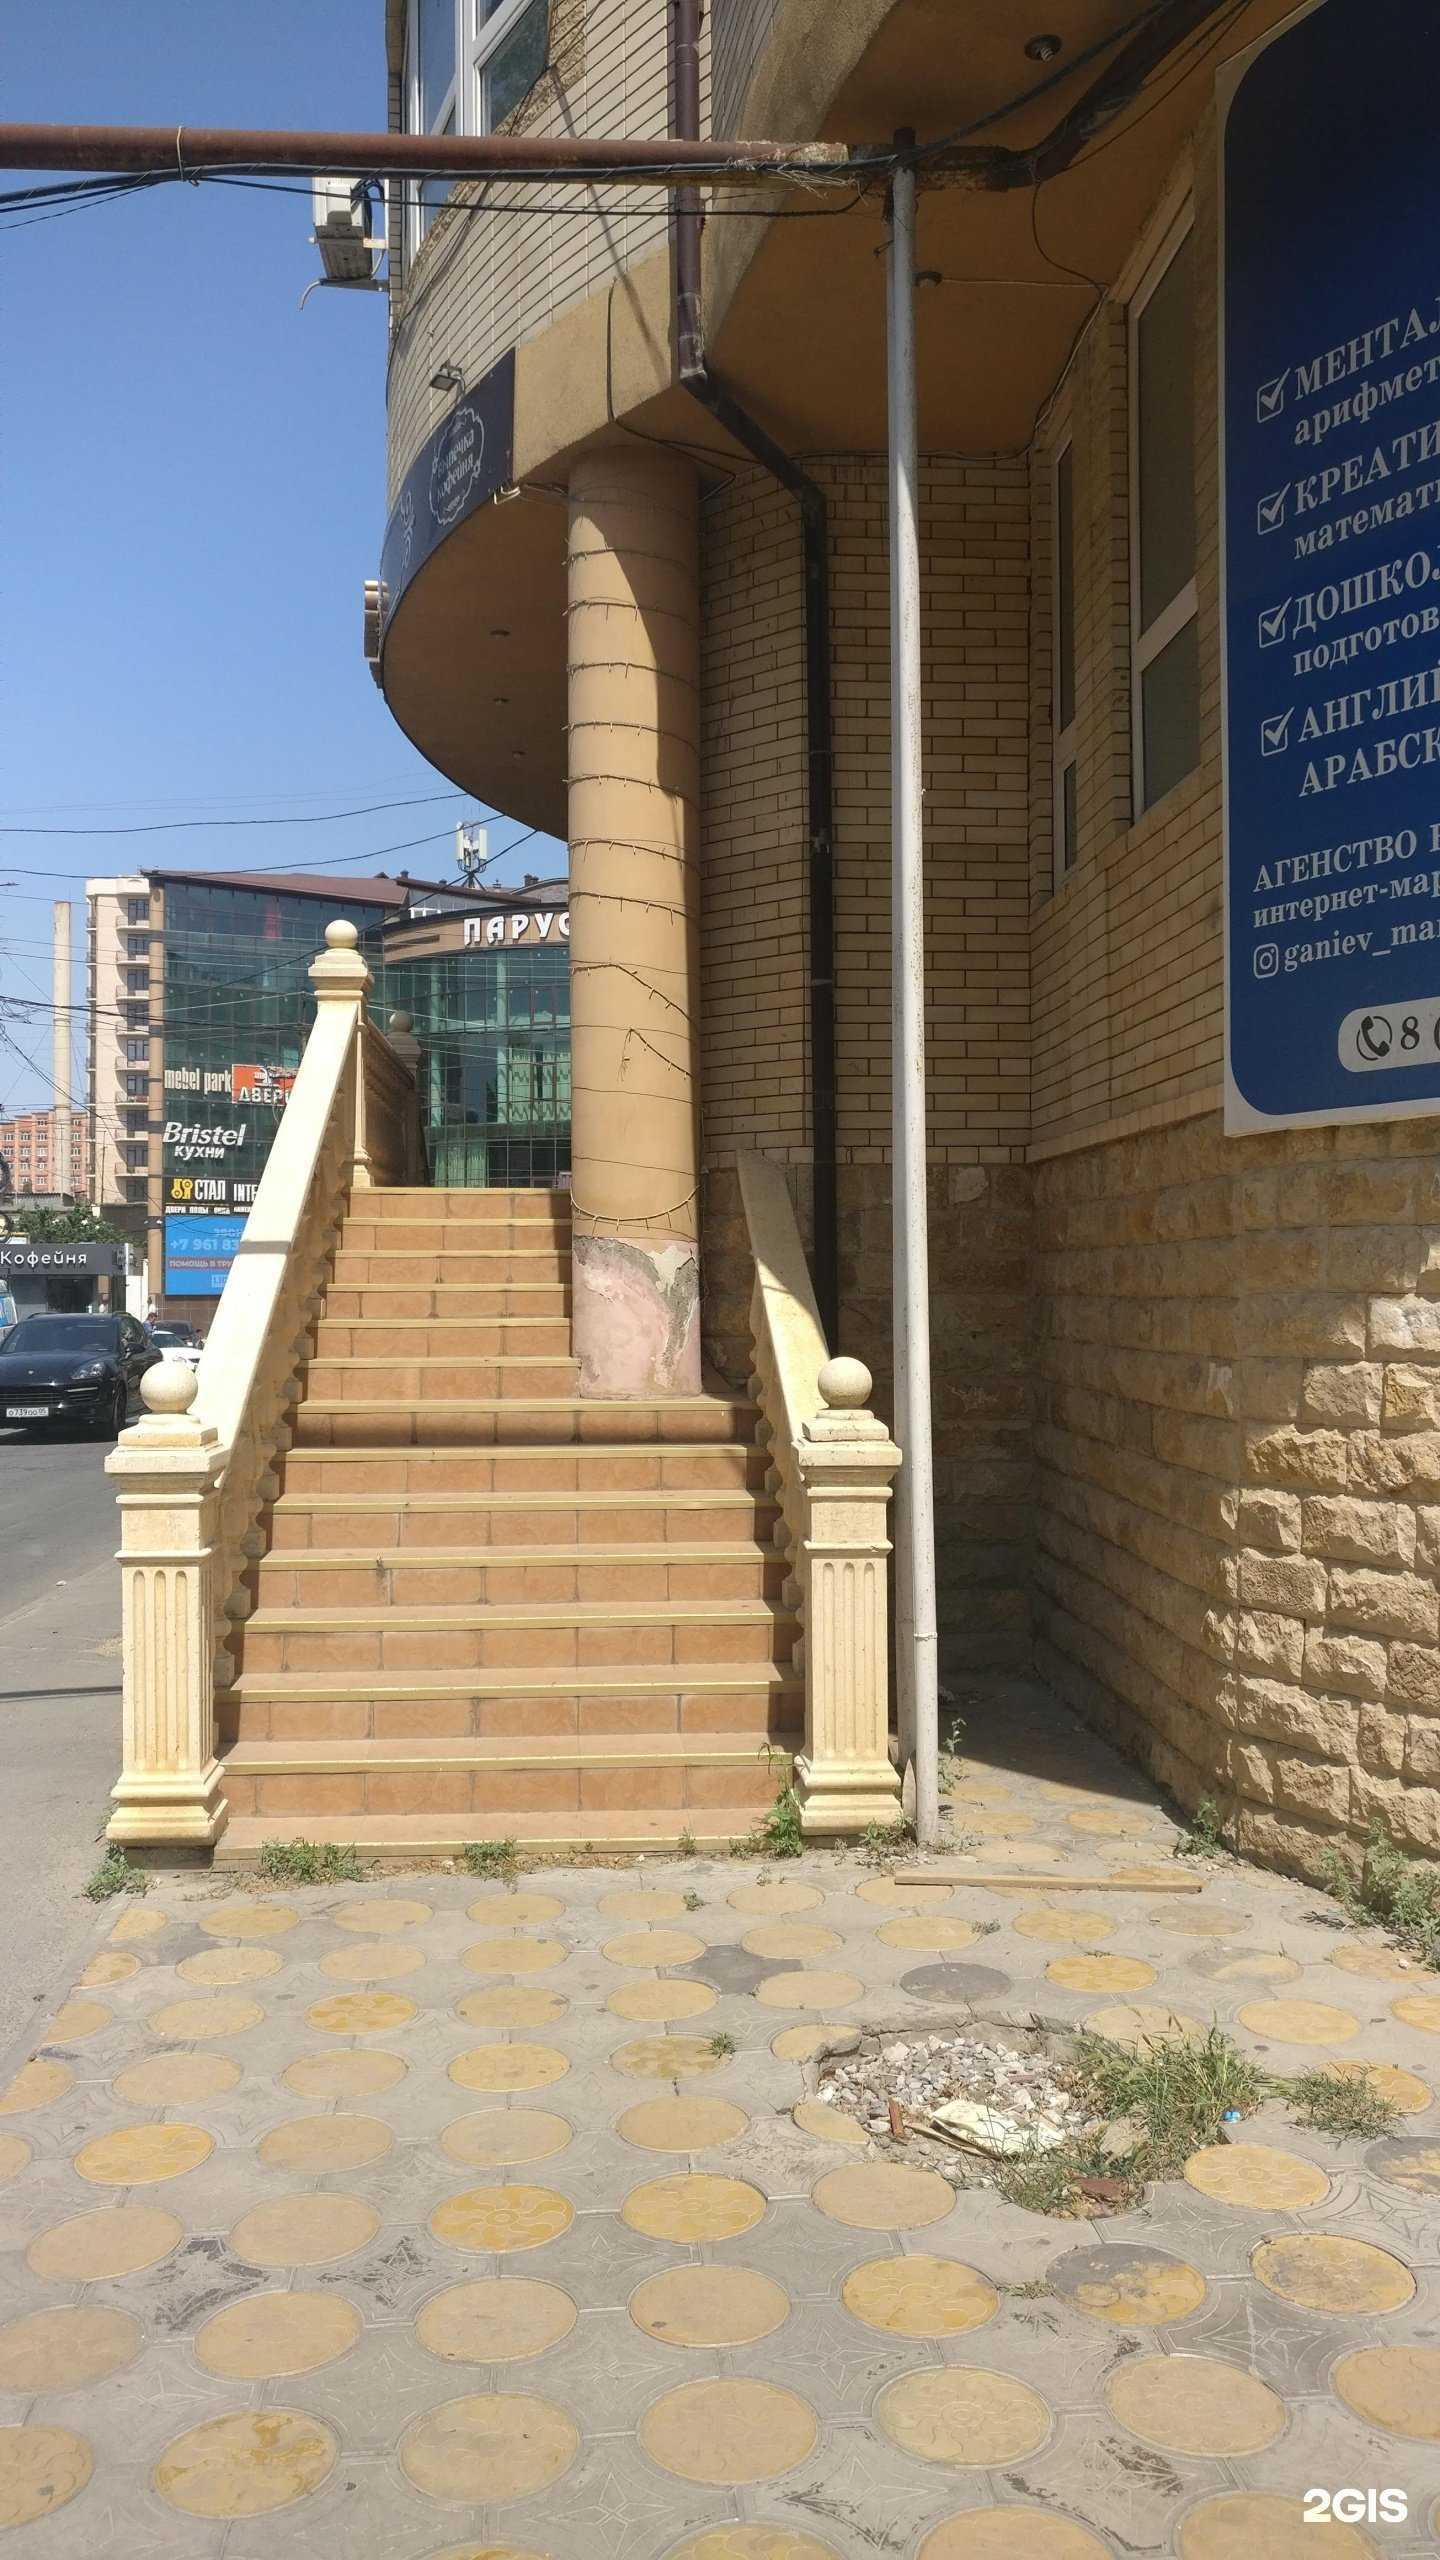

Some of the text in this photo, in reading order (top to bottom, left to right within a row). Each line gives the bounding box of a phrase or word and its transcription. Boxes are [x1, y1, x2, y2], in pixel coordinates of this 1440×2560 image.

[1294, 479, 1440, 560] математ
[1293, 606, 1440, 676] подготов
[1252, 829, 1418, 893] АГЕНСТВО
[164, 1067, 200, 1091] mebel
[203, 1070, 232, 1095] park
[162, 1121, 247, 1146] Bristel
[174, 1145, 225, 1160] кухни
[170, 1238, 189, 1250] +7
[192, 1238, 218, 1251] 961
[0, 1250, 88, 1268] Кофейня
